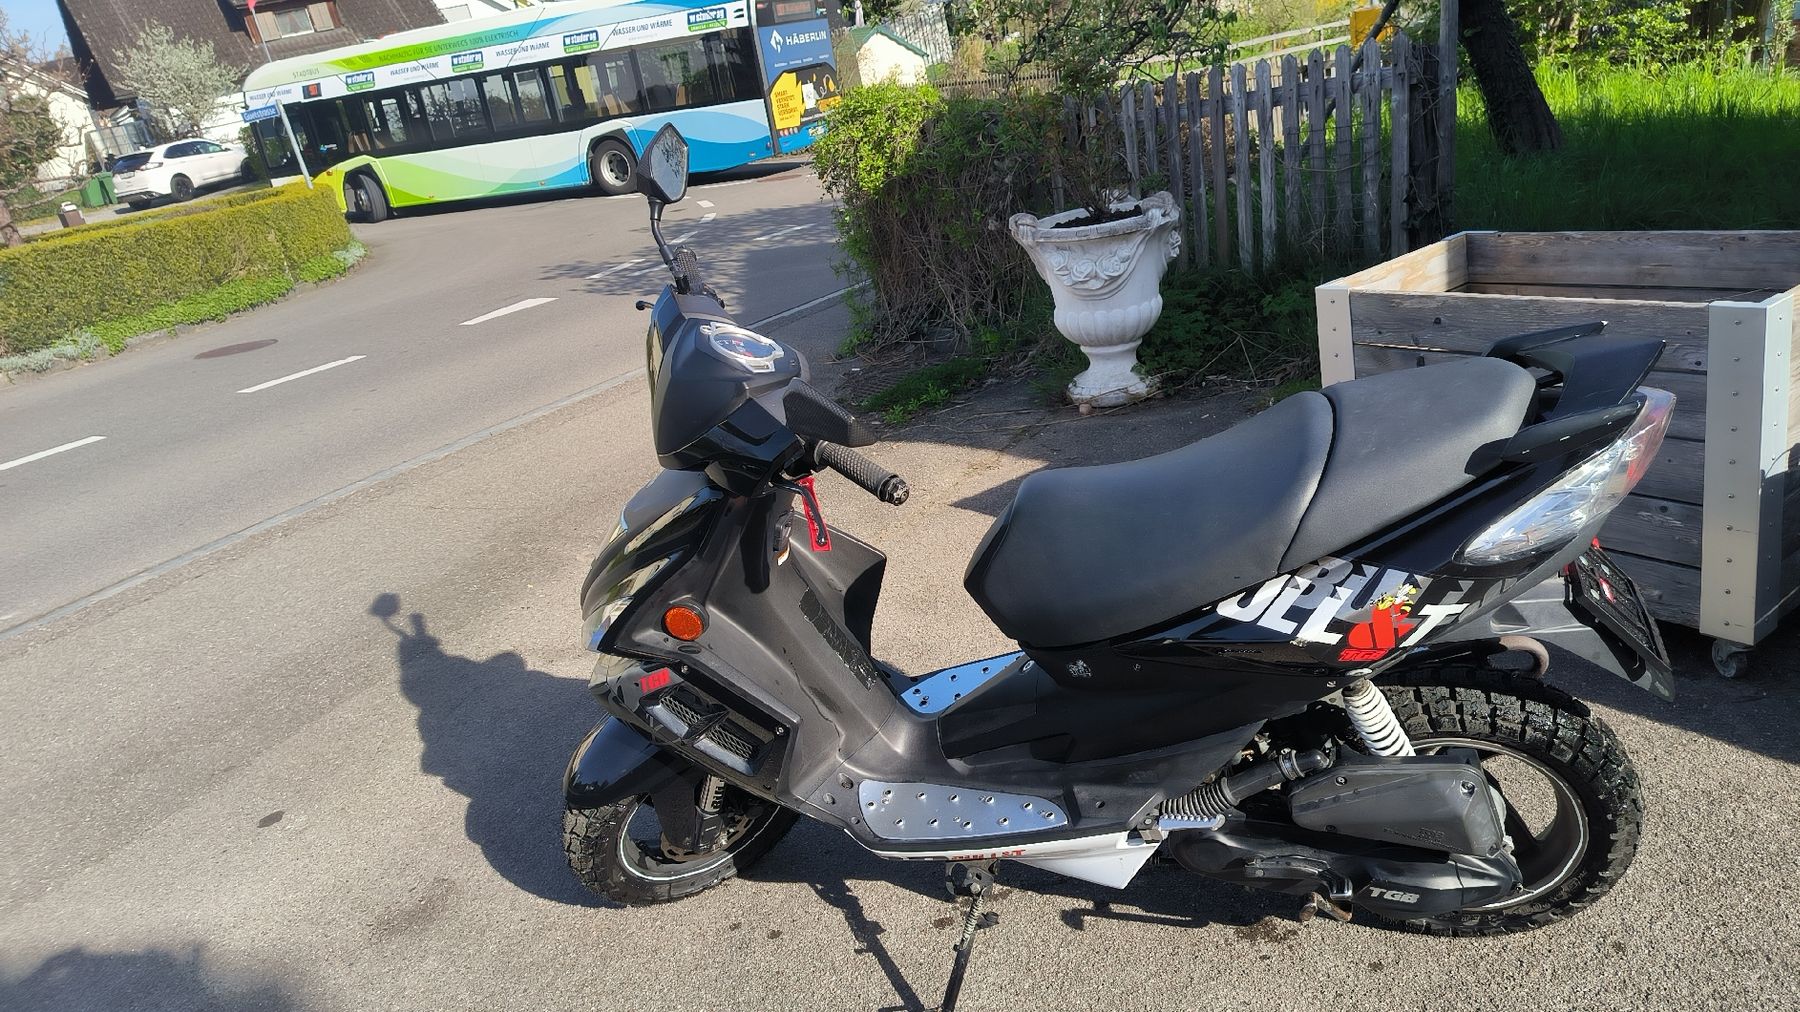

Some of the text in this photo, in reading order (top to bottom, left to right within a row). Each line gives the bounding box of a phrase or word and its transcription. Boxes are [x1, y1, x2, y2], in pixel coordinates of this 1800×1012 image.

[612, 19, 672, 36] WASSER UND WÄRME
[433, 39, 469, 52] UNTERWEGS
[484, 30, 519, 43] ELEKTRISCH
[785, 30, 827, 46] HÄBERLIN
[495, 48, 517, 57] WASSER
[530, 41, 550, 51] WÄRME
[1370, 887, 1420, 904] TGB
